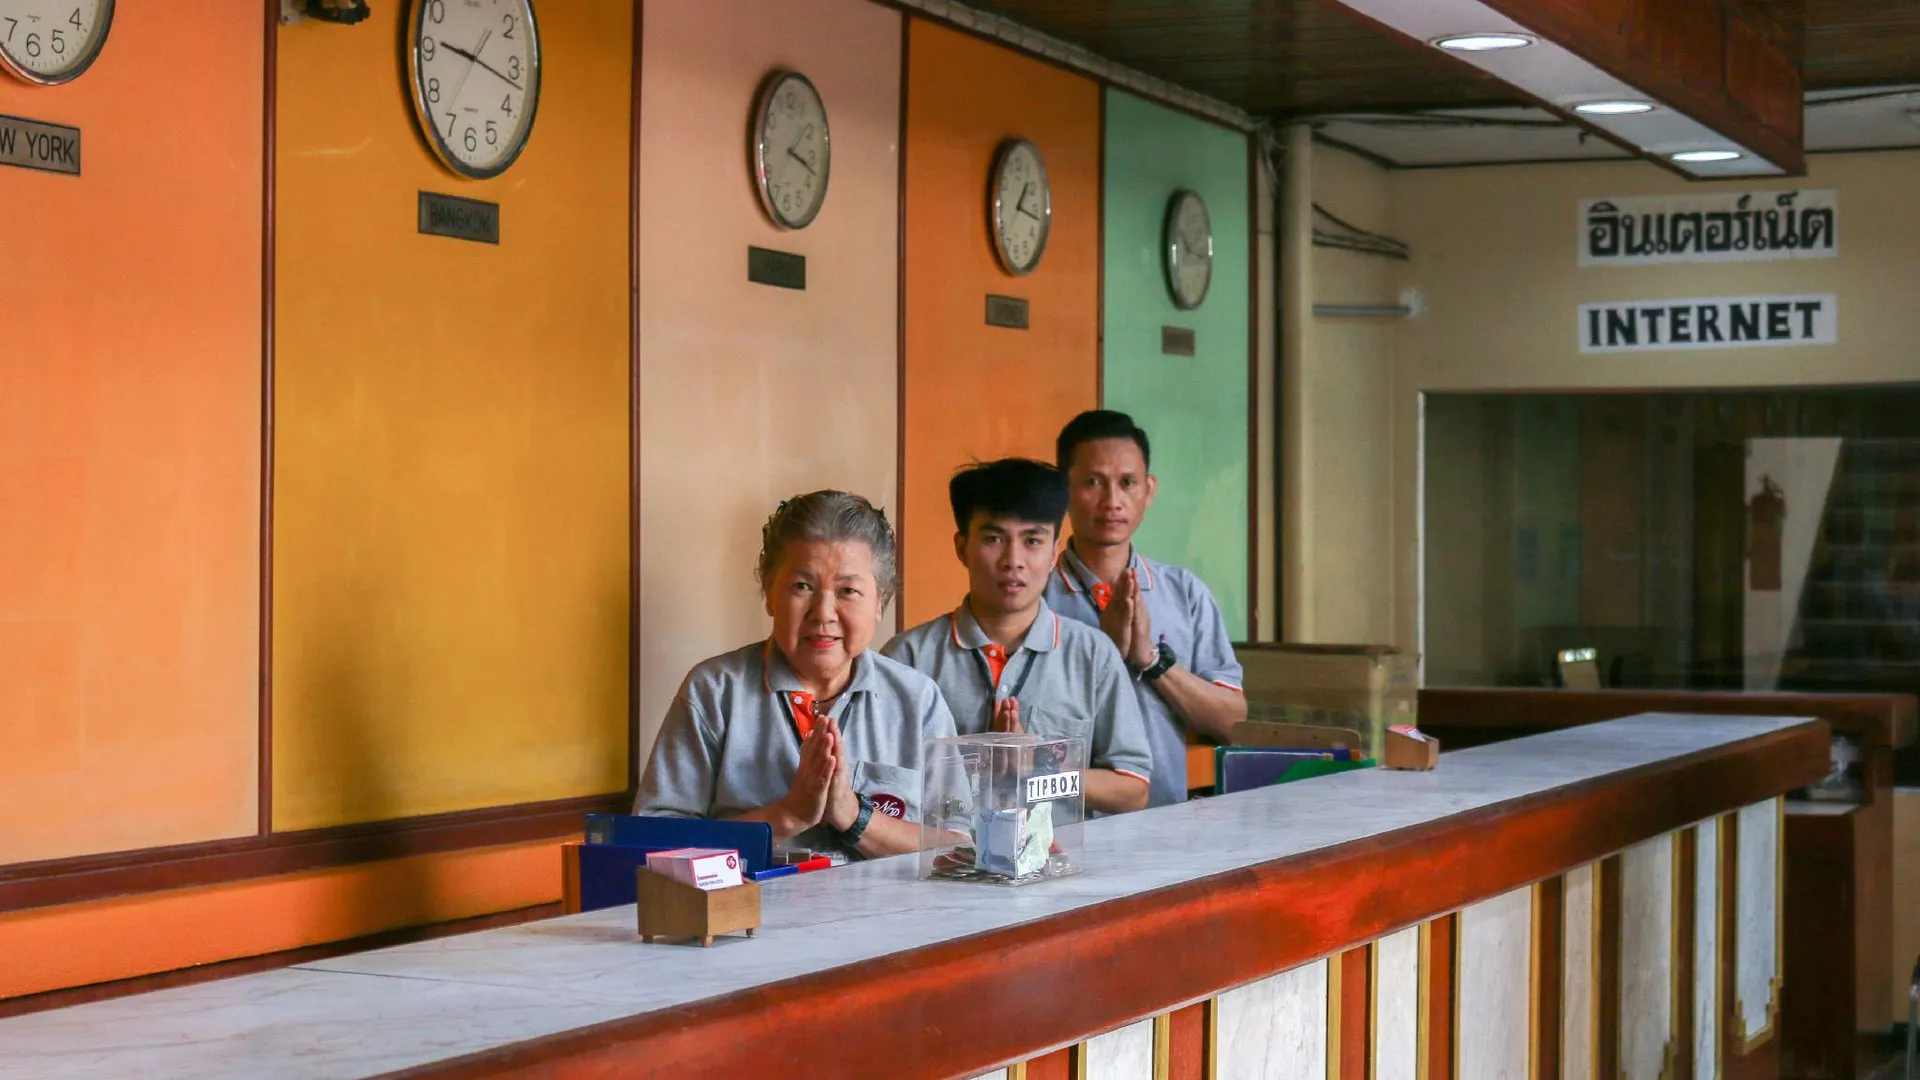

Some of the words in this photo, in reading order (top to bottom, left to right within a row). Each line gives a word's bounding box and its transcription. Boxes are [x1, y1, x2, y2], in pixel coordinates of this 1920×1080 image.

[4, 18, 18, 42] 7
[69, 8, 82, 31] 4
[502, 14, 514, 39] 2
[26, 33, 41, 57] 6
[51, 30, 65, 54] 5
[422, 36, 434, 61] 9
[508, 56, 520, 80] 3
[428, 78, 440, 103] 8
[501, 94, 512, 118] 4
[445, 112, 456, 137] 7
[485, 121, 497, 145] 5
[26, 131, 74, 165] YORK
[464, 127, 477, 152] 6
[430, 203, 491, 233] BANGKOK
[1588, 192, 1834, 257] อินเตอร์เน็ต
[1588, 302, 1822, 346] INTERNET
[1029, 775, 1078, 797] TIPBOX
